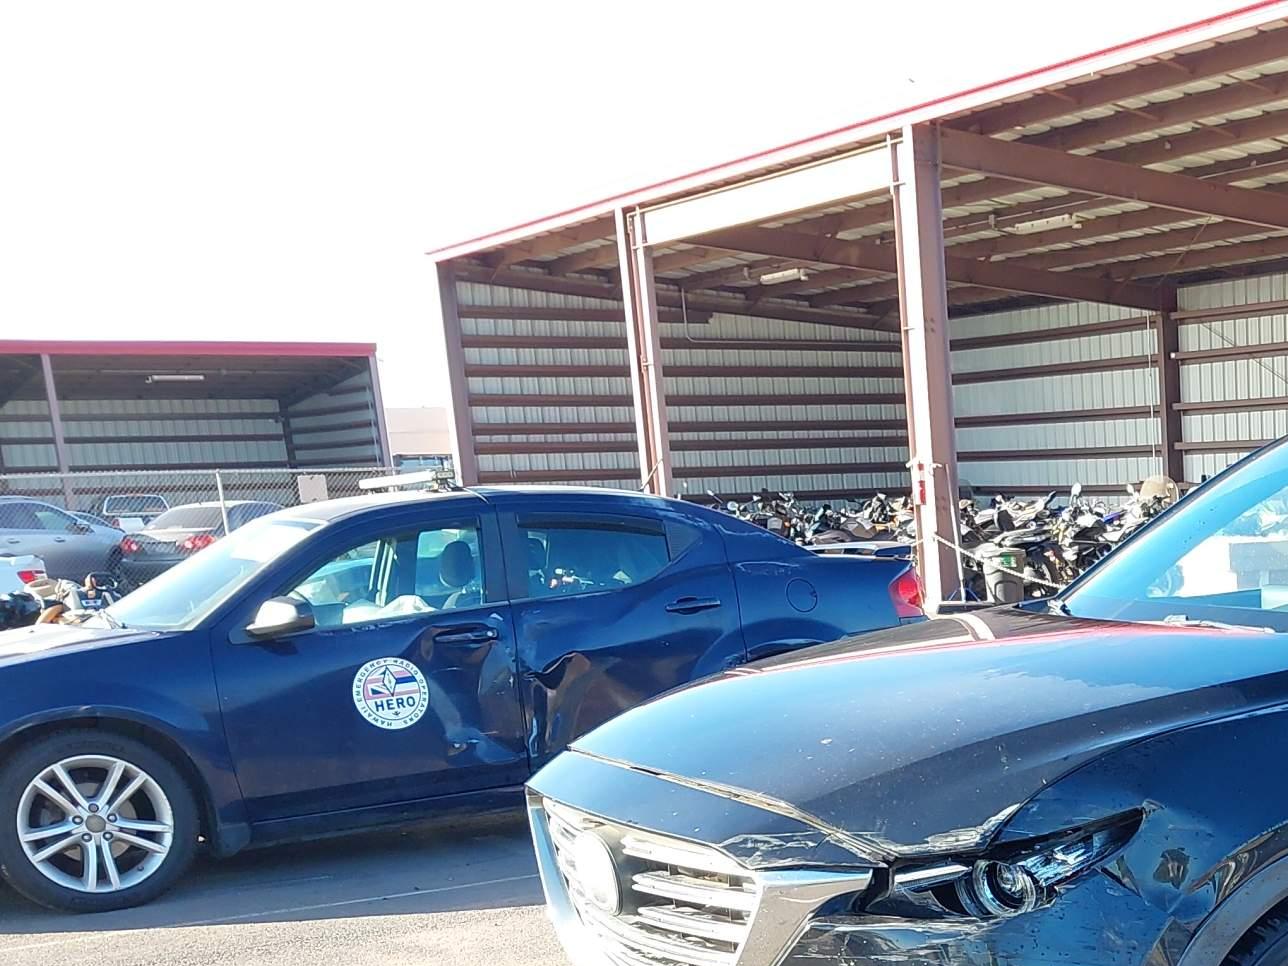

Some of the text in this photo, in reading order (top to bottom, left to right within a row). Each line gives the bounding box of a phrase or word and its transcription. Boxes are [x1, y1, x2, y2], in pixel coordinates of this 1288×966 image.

[355, 660, 427, 726] HAWAII EMERGENCY RADIO OPERATORS
[374, 696, 416, 712] HERO
